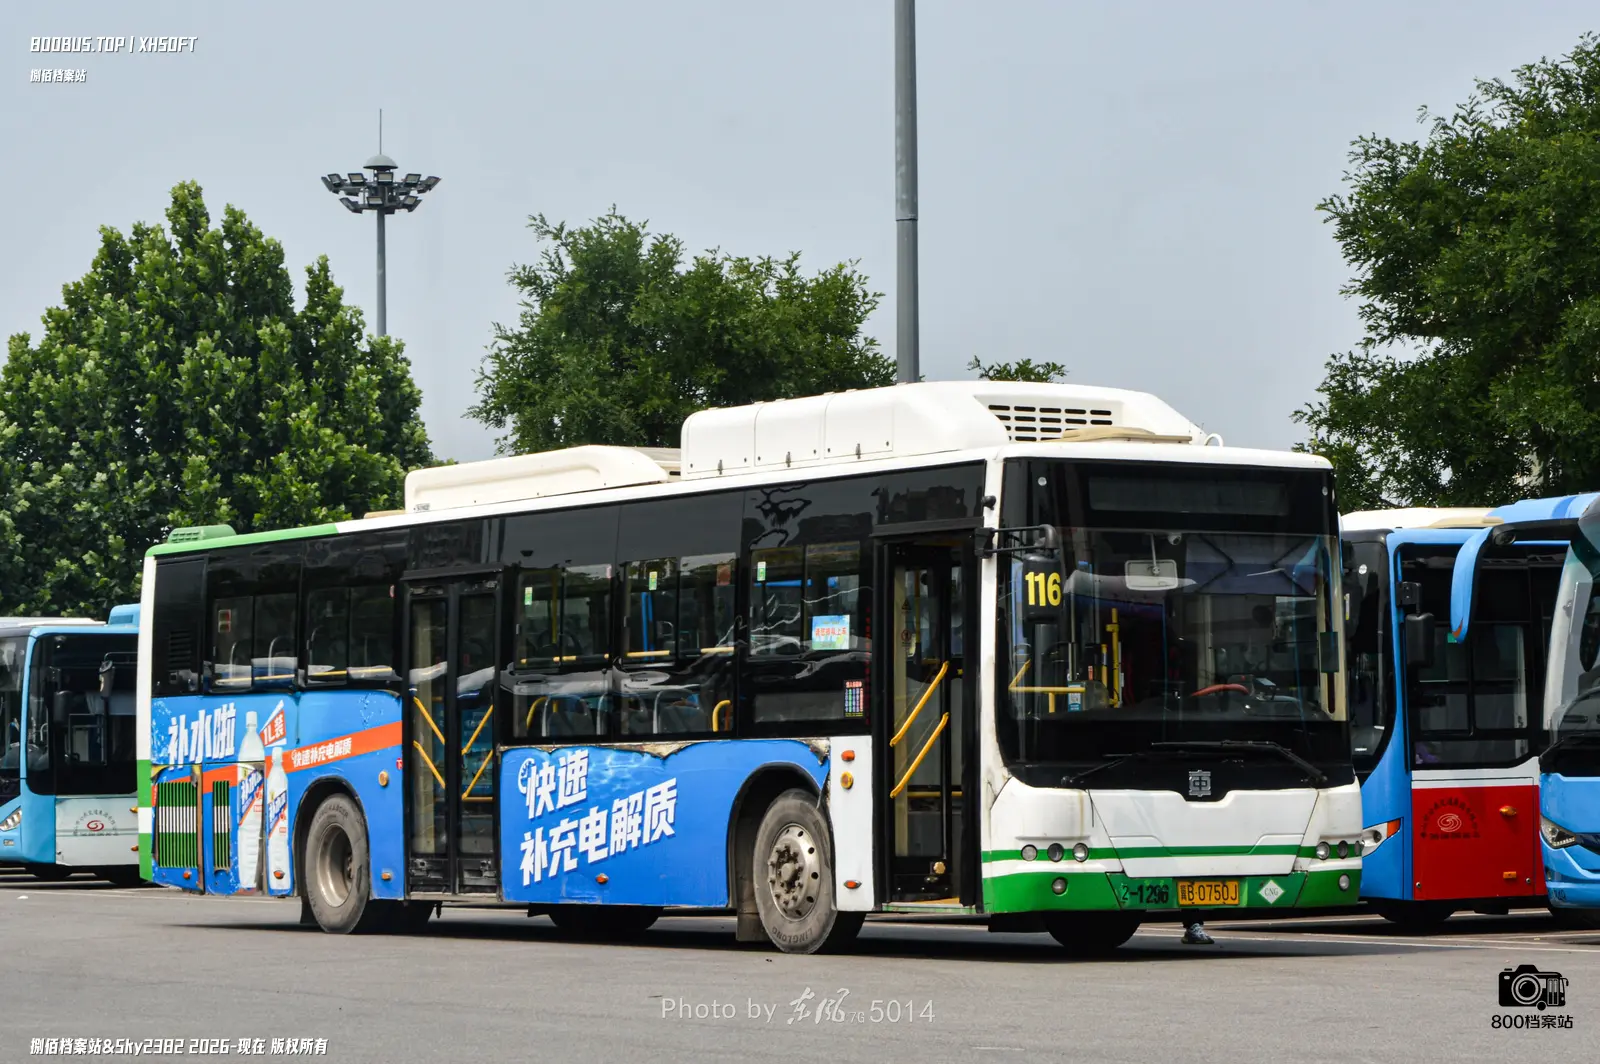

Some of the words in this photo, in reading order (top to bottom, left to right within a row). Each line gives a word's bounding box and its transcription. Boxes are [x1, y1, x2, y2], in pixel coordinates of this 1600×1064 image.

[1025, 571, 1062, 607] 116
[167, 702, 236, 772] 补水啦
[263, 714, 284, 745] 1L装
[292, 737, 352, 768] 快速补充电解质
[525, 749, 589, 820] 快速
[519, 778, 677, 886] 补充电解质
[1263, 886, 1280, 897] CNG
